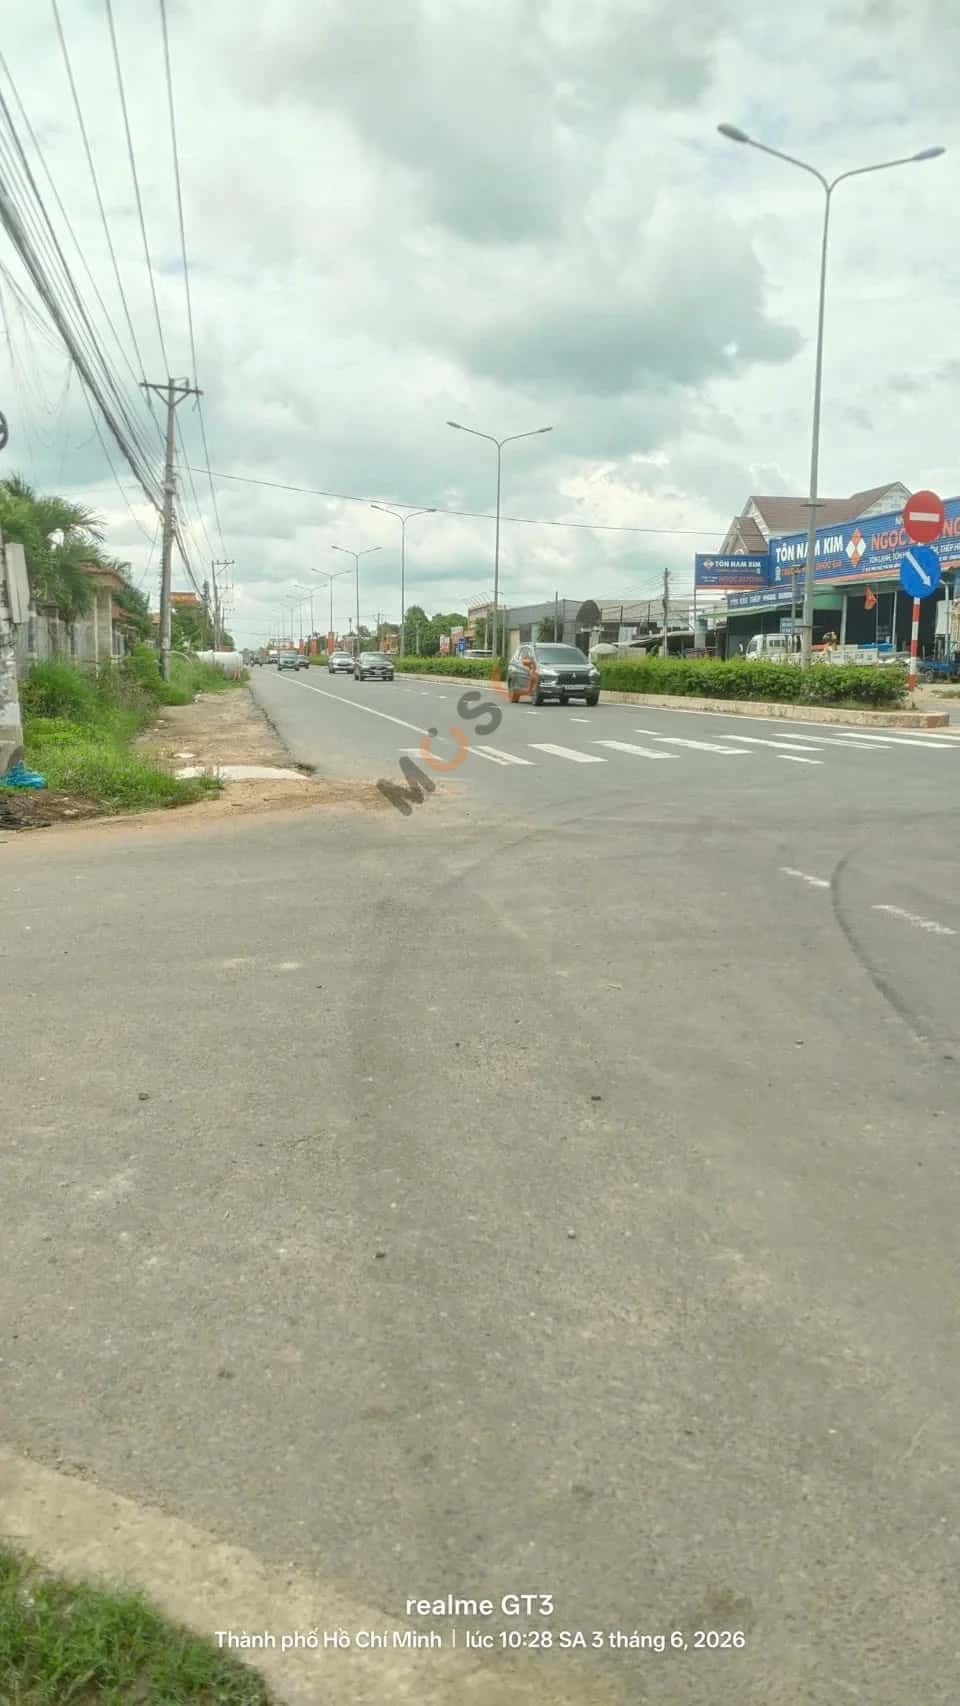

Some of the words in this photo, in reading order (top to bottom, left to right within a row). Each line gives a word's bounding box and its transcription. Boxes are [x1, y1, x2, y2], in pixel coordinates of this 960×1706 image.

[775, 542, 796, 563] TÔN
[823, 534, 844, 555] KIM
[714, 559, 730, 568] TÔN
